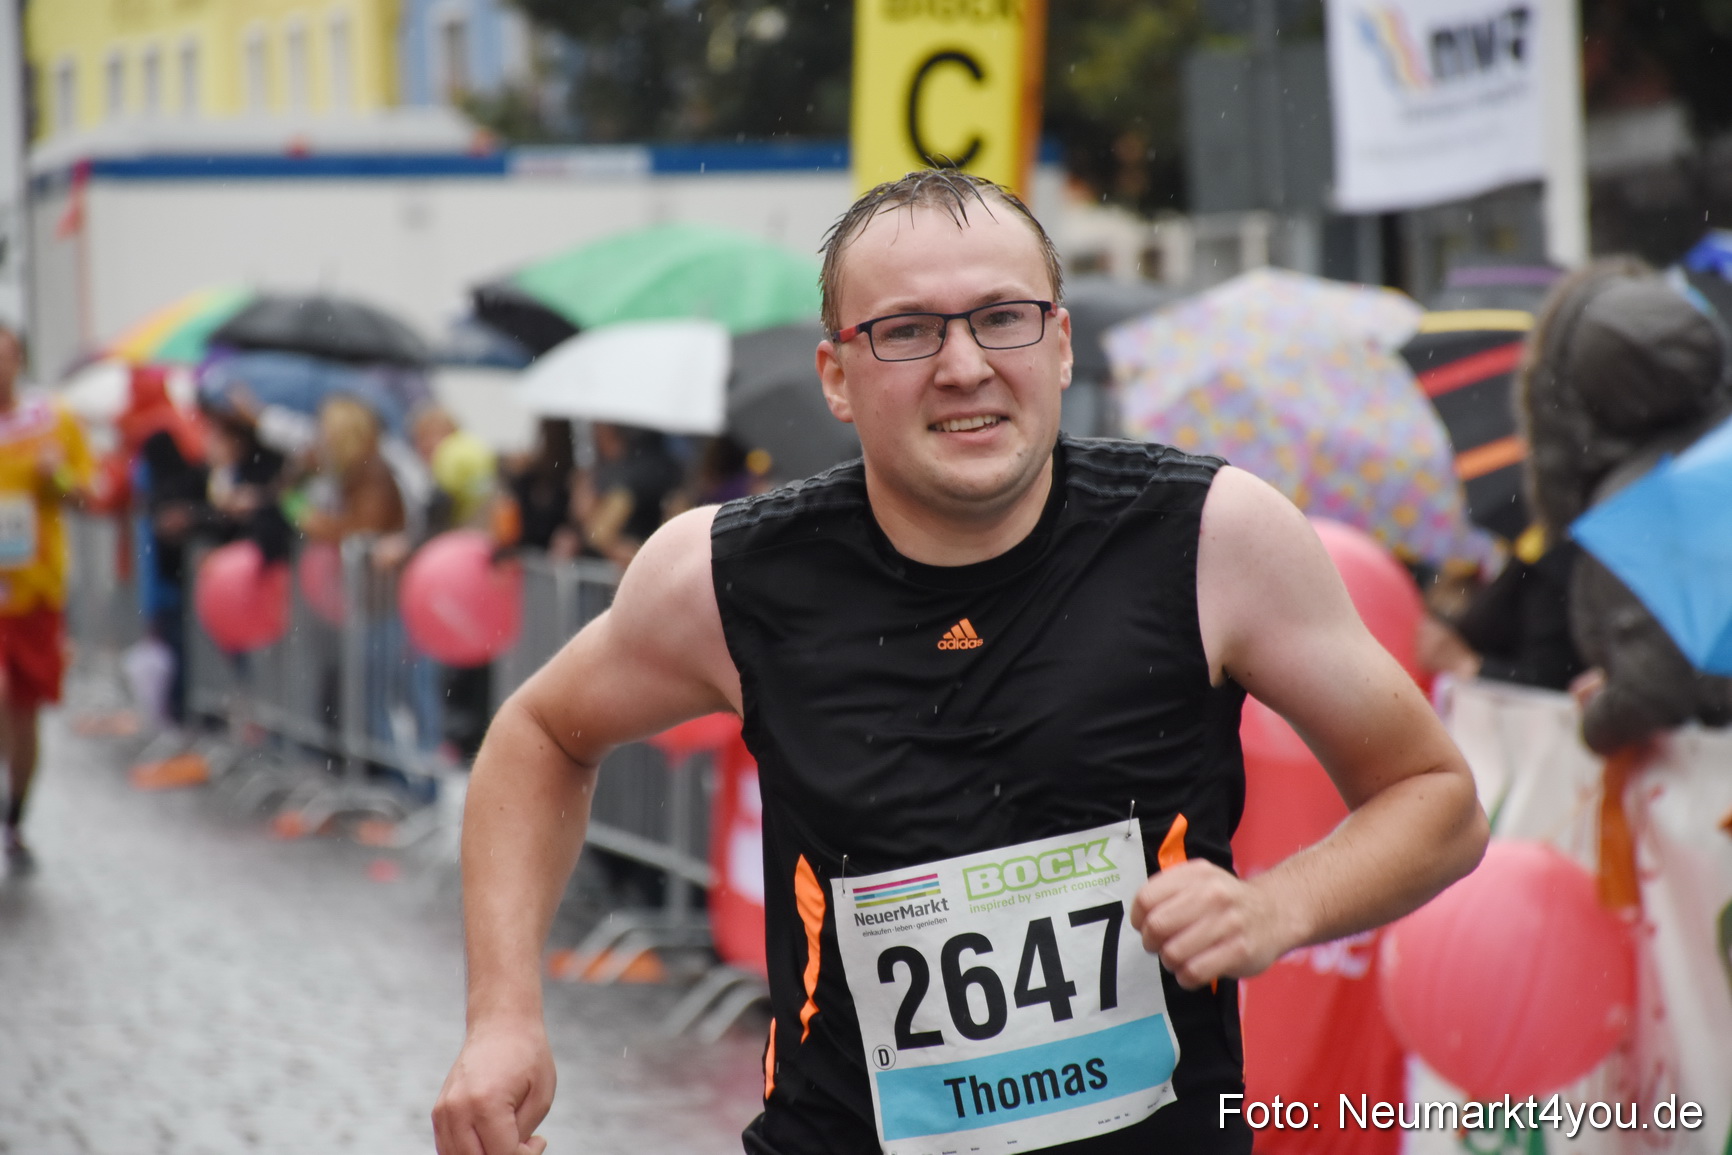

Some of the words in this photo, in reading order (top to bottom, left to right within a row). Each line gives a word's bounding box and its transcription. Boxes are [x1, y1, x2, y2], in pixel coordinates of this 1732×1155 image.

[905, 48, 984, 170] C
[937, 638, 984, 650] adidas
[962, 837, 1118, 901] BOCK
[969, 895, 1016, 914] inspired
[1018, 894, 1031, 907] by
[1035, 884, 1068, 900] smart
[1071, 873, 1121, 893] concepts
[854, 897, 950, 927] NeuerMarkt
[876, 900, 1125, 1051] 2647
[878, 1049, 890, 1067] D
[943, 1057, 1109, 1119] Thomas
